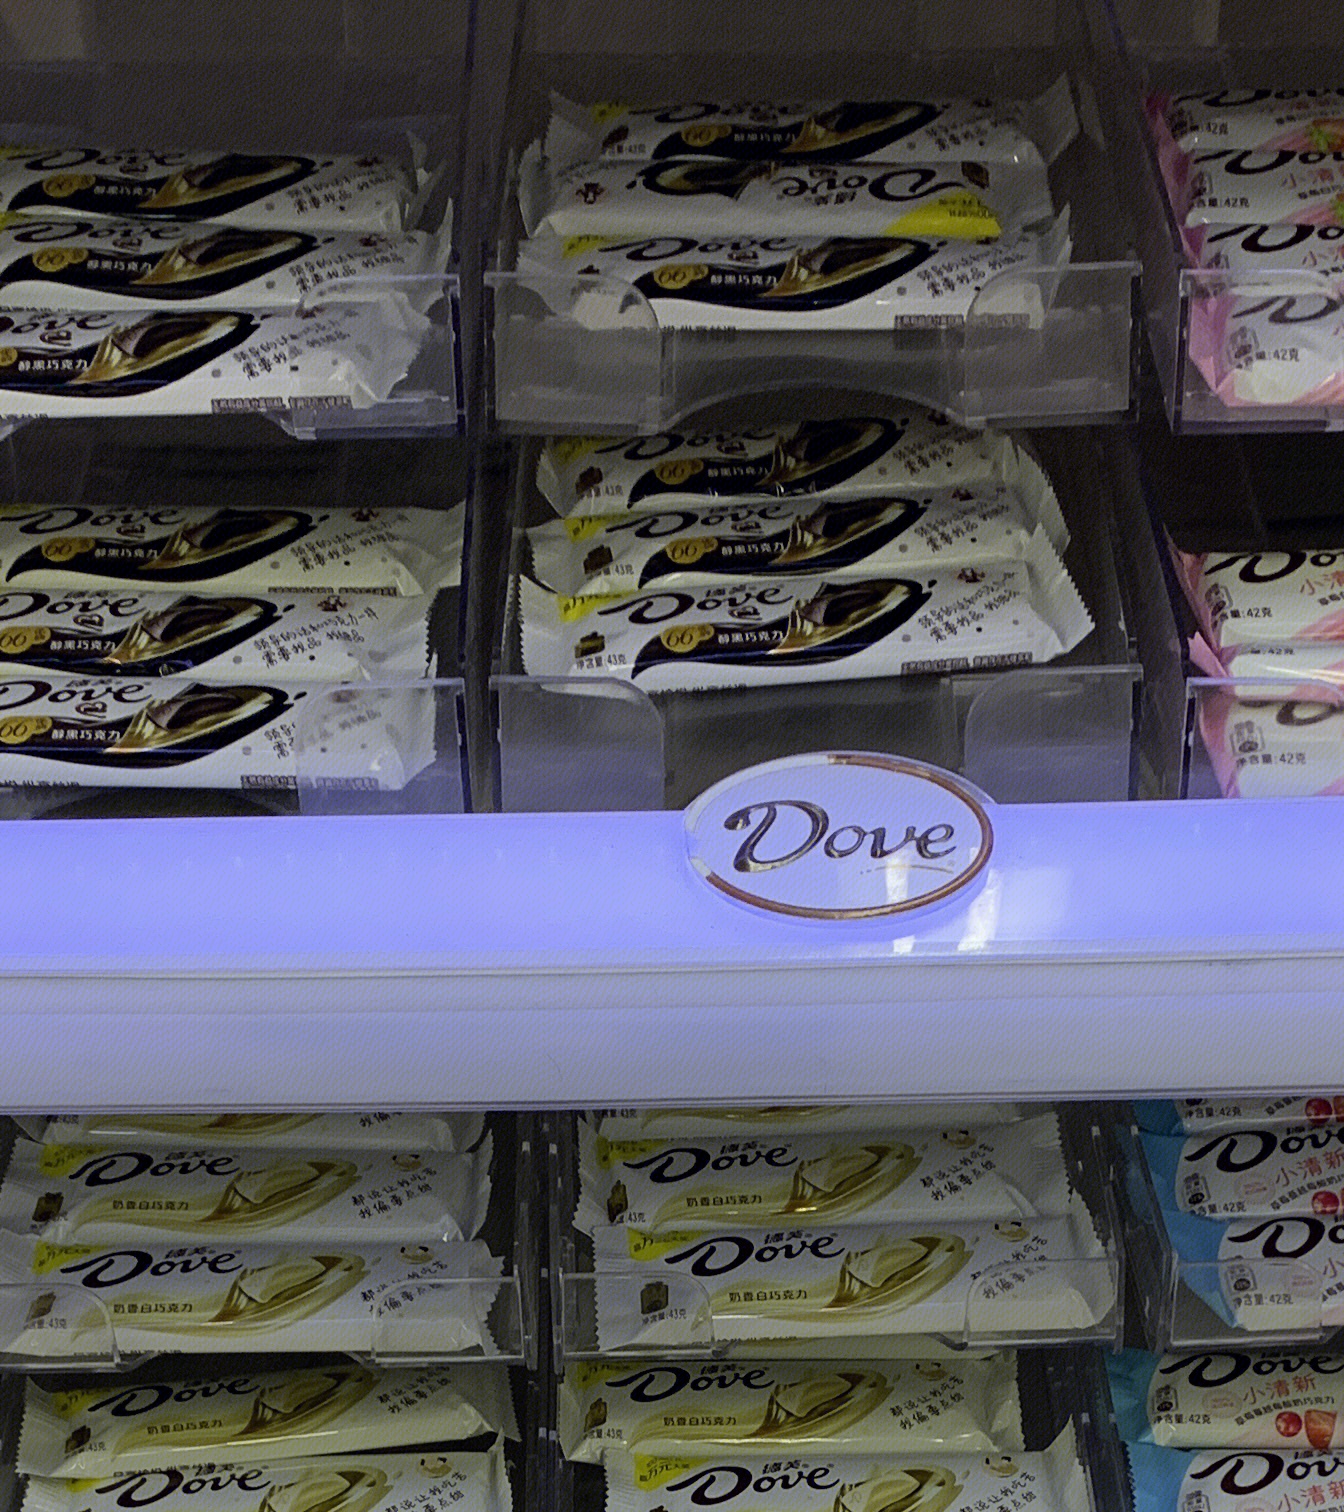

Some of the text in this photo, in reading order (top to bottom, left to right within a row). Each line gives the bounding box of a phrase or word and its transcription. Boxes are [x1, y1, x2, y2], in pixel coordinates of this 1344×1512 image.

[0, 506, 182, 535] Dove
[596, 587, 794, 625] Dove
[723, 799, 956, 873] Dove
[69, 1152, 240, 1188] Dove
[623, 1145, 798, 1184] Dove
[60, 1249, 243, 1289] Dove
[664, 1233, 846, 1277] Dove
[606, 1367, 776, 1403] Dove
[1242, 1376, 1318, 1406] 小清新
[95, 1466, 272, 1508] Dove
[666, 1466, 841, 1506] Dove
